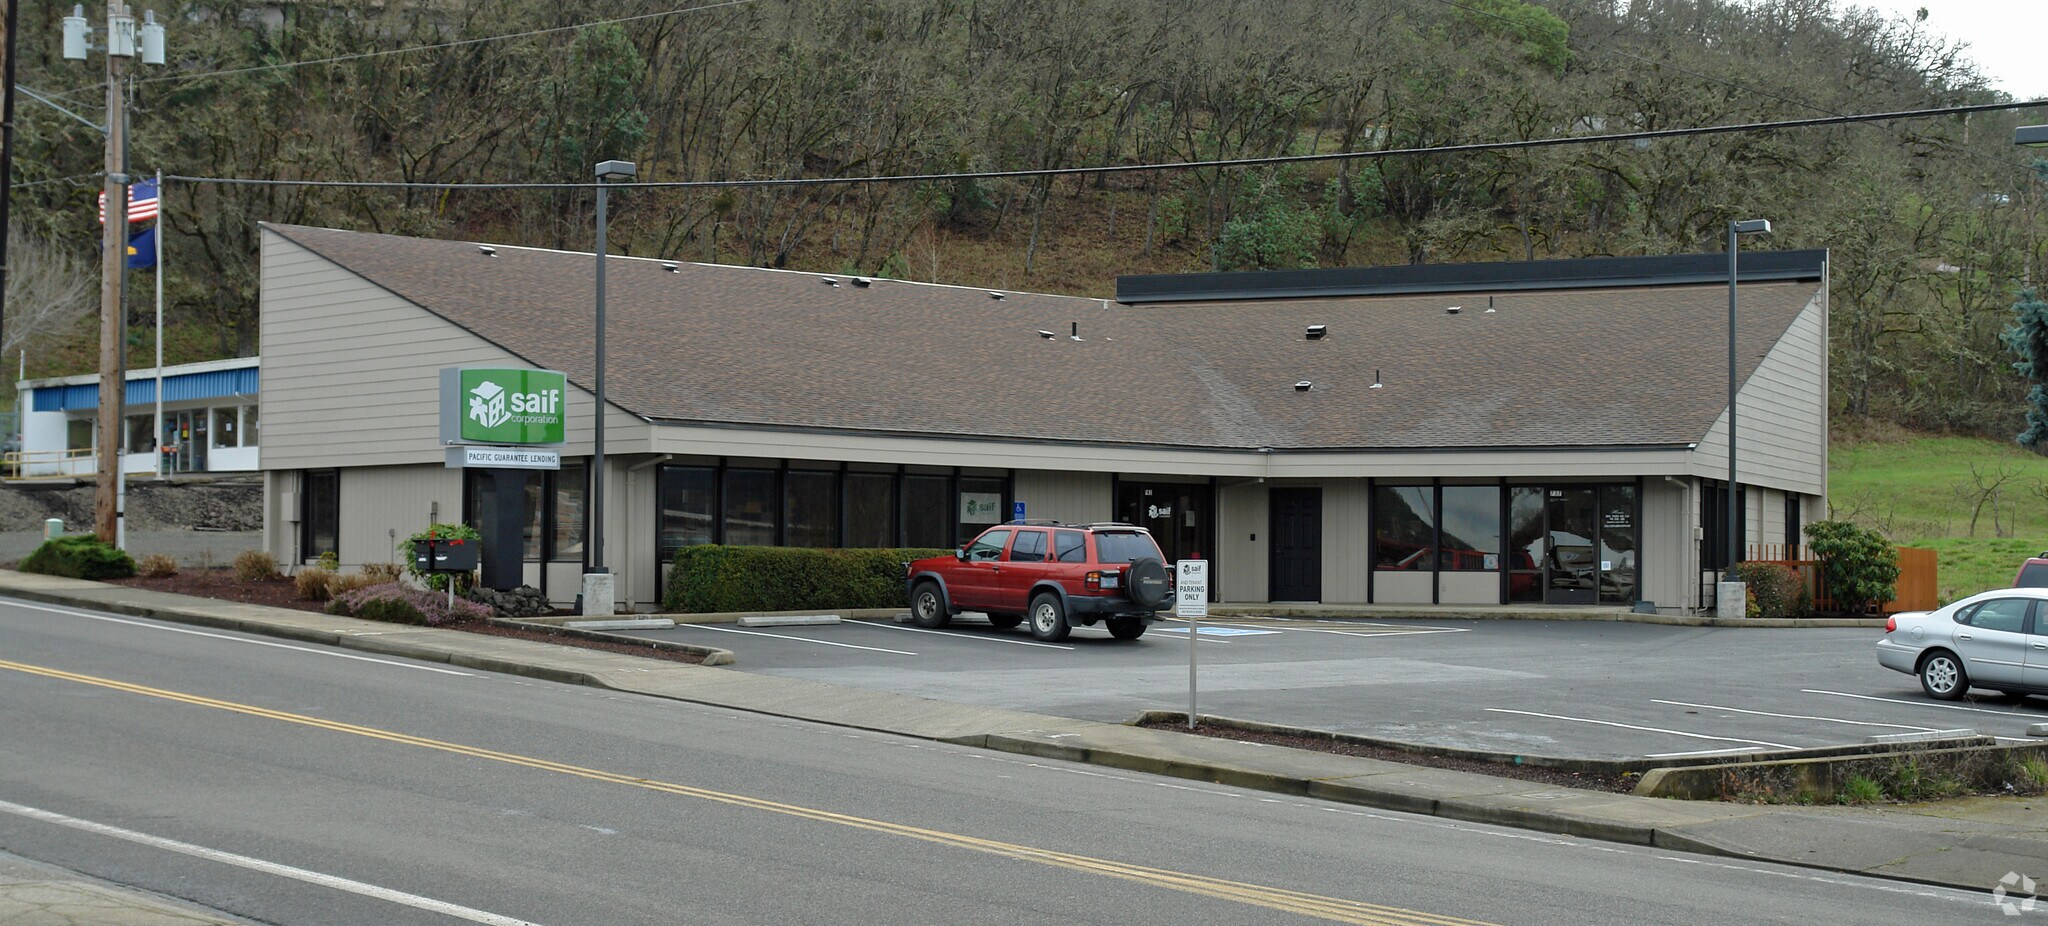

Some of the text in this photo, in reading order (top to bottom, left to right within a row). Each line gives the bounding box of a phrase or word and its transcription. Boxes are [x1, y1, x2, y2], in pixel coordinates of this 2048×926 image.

[511, 389, 559, 414] saif
[511, 414, 558, 426] corporation
[468, 453, 492, 461] PACIFIC
[494, 454, 528, 463] GUARANTEE
[979, 502, 996, 512] saif
[1158, 506, 1172, 515] saif
[1179, 585, 1205, 593] PARKING
[1184, 593, 1200, 601] ONLY
